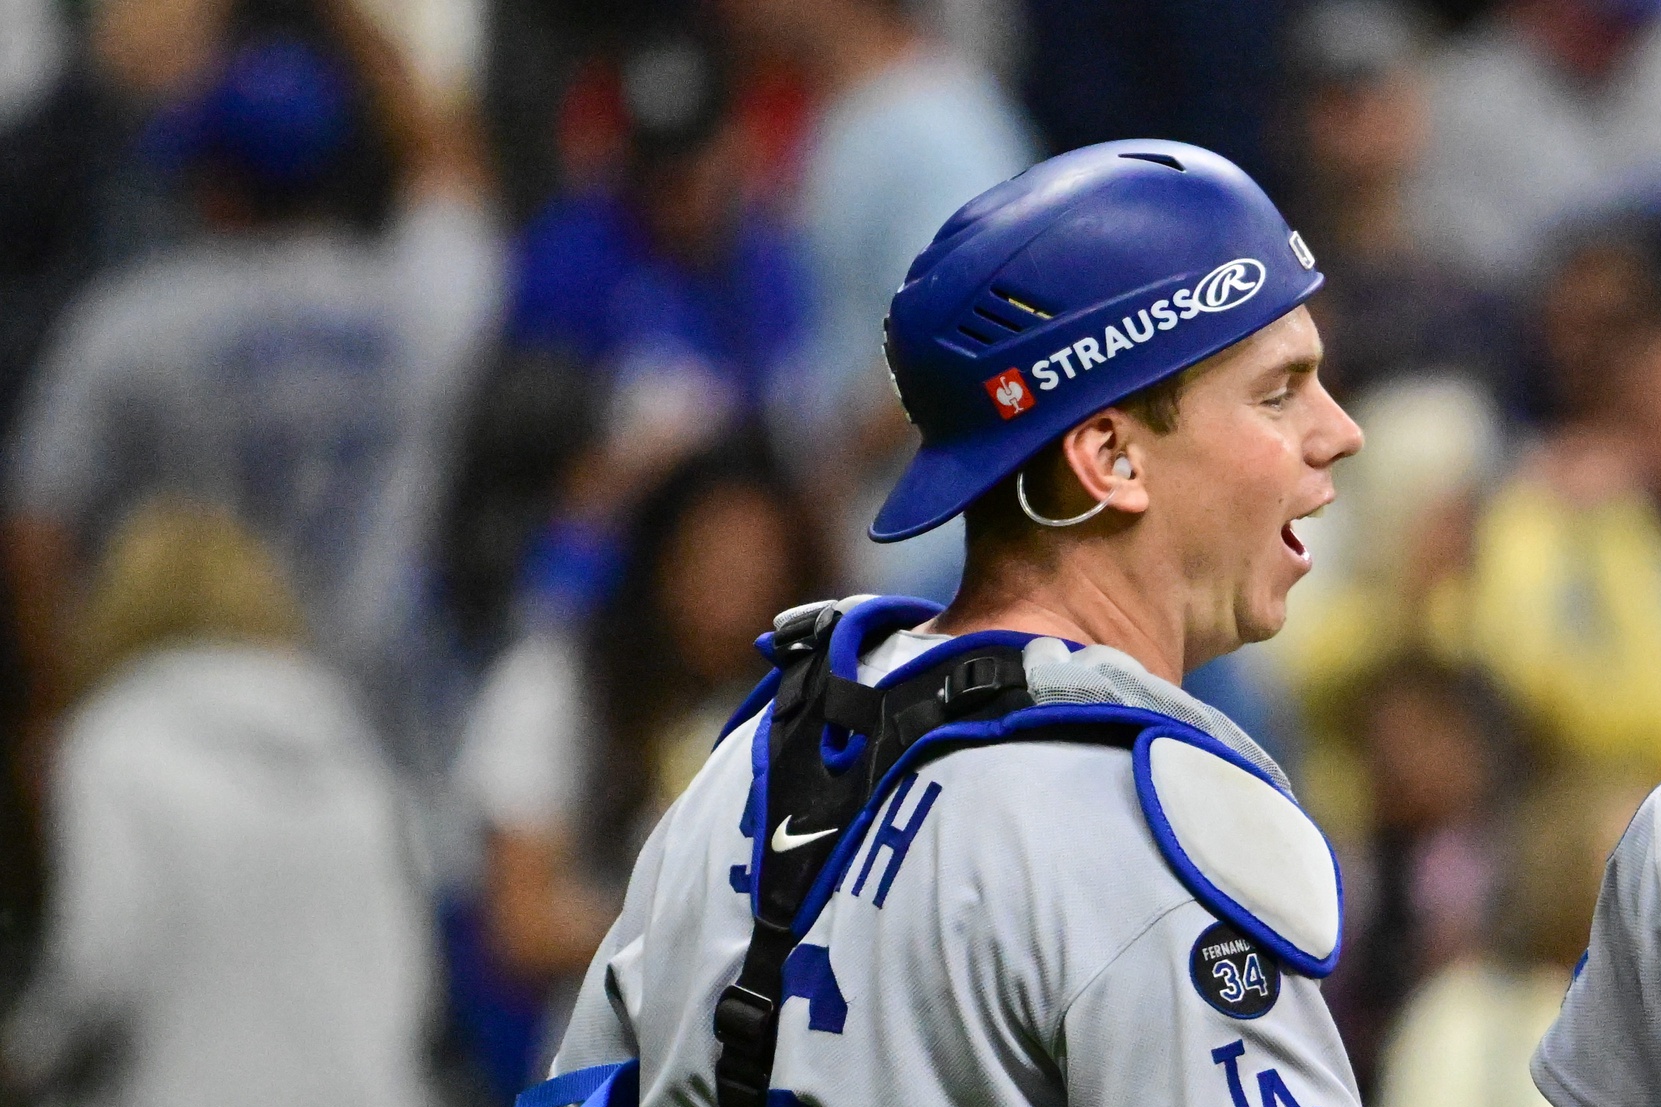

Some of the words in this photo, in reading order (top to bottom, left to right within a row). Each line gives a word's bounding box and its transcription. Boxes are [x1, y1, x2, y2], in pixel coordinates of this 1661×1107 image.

[1031, 288, 1200, 391] STRAUSS
[1201, 938, 1256, 961] FERNAND
[1211, 952, 1268, 1003] 34
